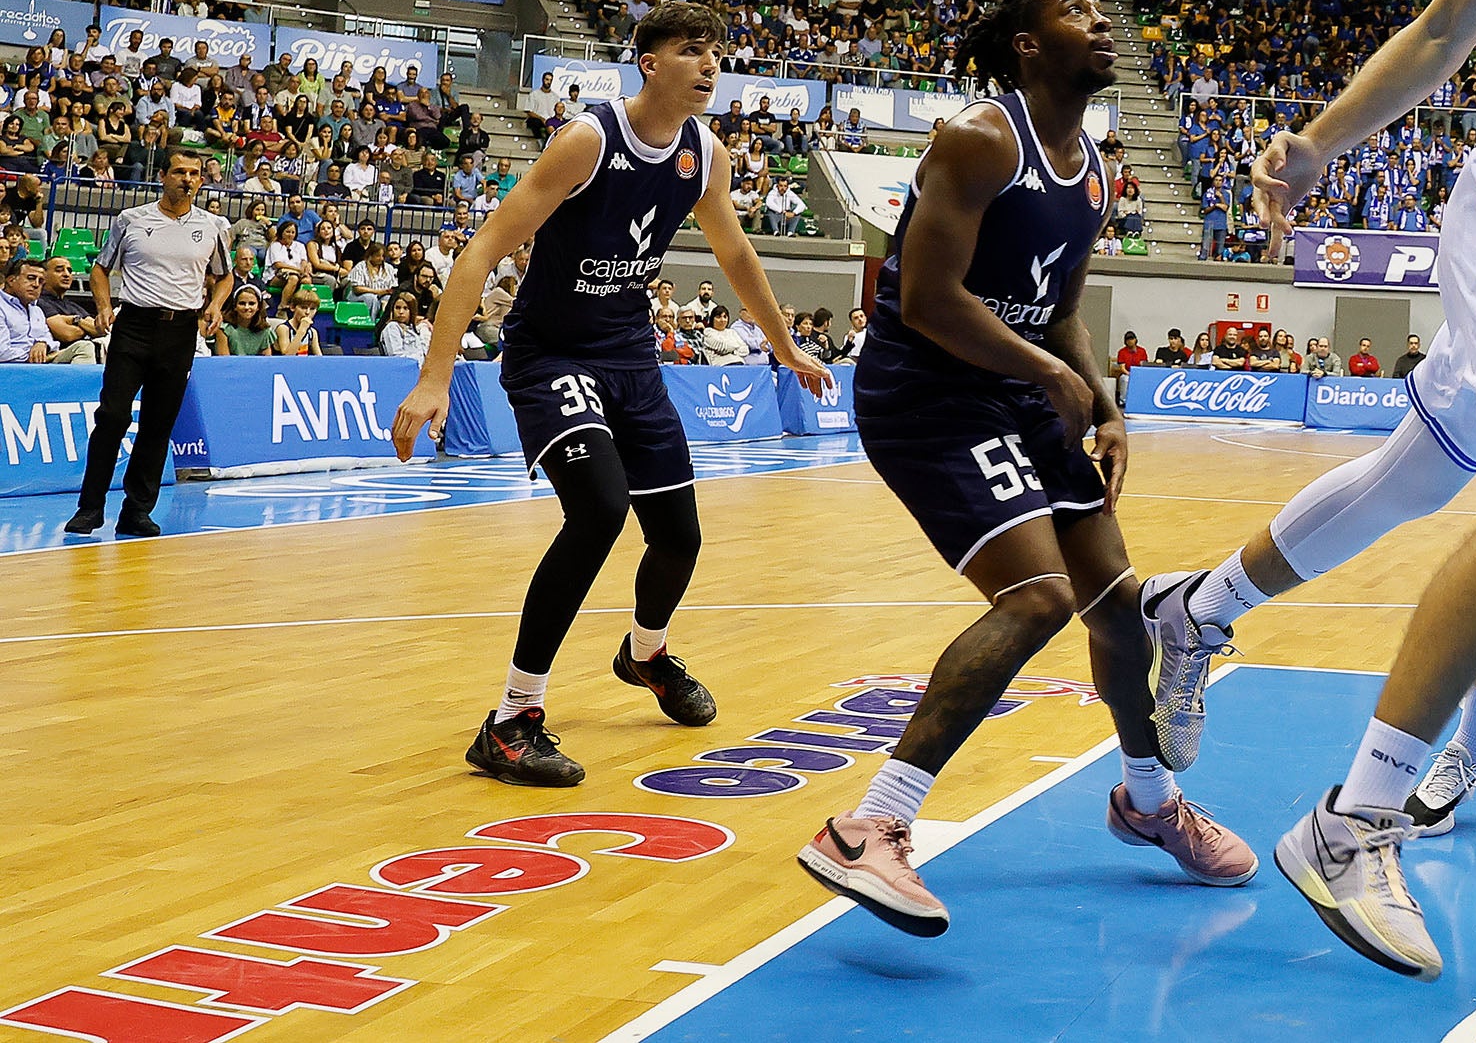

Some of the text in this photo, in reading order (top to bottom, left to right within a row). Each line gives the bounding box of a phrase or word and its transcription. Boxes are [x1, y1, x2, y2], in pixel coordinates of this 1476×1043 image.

[573, 279, 622, 297] Burgos
[271, 373, 392, 444] Avnt.
[551, 374, 604, 417] 35
[1153, 371, 1278, 413] Coca-Cola
[1316, 385, 1408, 407] Diario de
[970, 433, 1044, 502] 55
